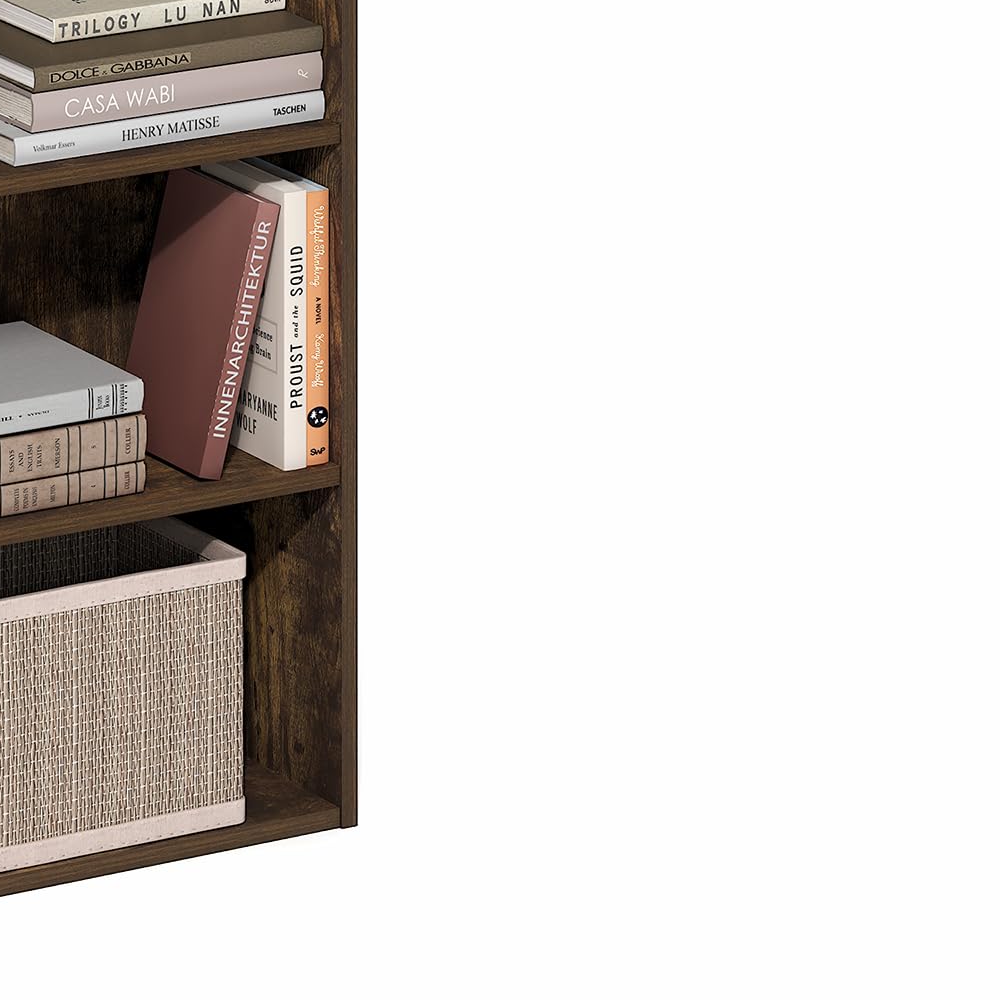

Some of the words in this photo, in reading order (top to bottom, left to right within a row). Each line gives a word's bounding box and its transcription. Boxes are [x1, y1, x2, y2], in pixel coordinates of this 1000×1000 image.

[58, 12, 141, 38] TRILOGY
[164, 5, 187, 23] LU
[50, 67, 99, 84] DOLCE
[110, 54, 190, 74] GABBANA
[64, 93, 120, 118] CASA
[126, 83, 175, 107] WABI
[272, 103, 307, 116] TASCHEN
[121, 123, 165, 142] HENRY
[167, 115, 220, 135] MATISSE
[32, 142, 57, 153] Volkmar
[289, 245, 304, 297] SQUID
[291, 305, 299, 318] the
[213, 221, 272, 438] INNENARCHITEKTUR
[255, 343, 272, 360] Brain
[289, 343, 304, 409] PROUST
[236, 411, 257, 435] WOLF
